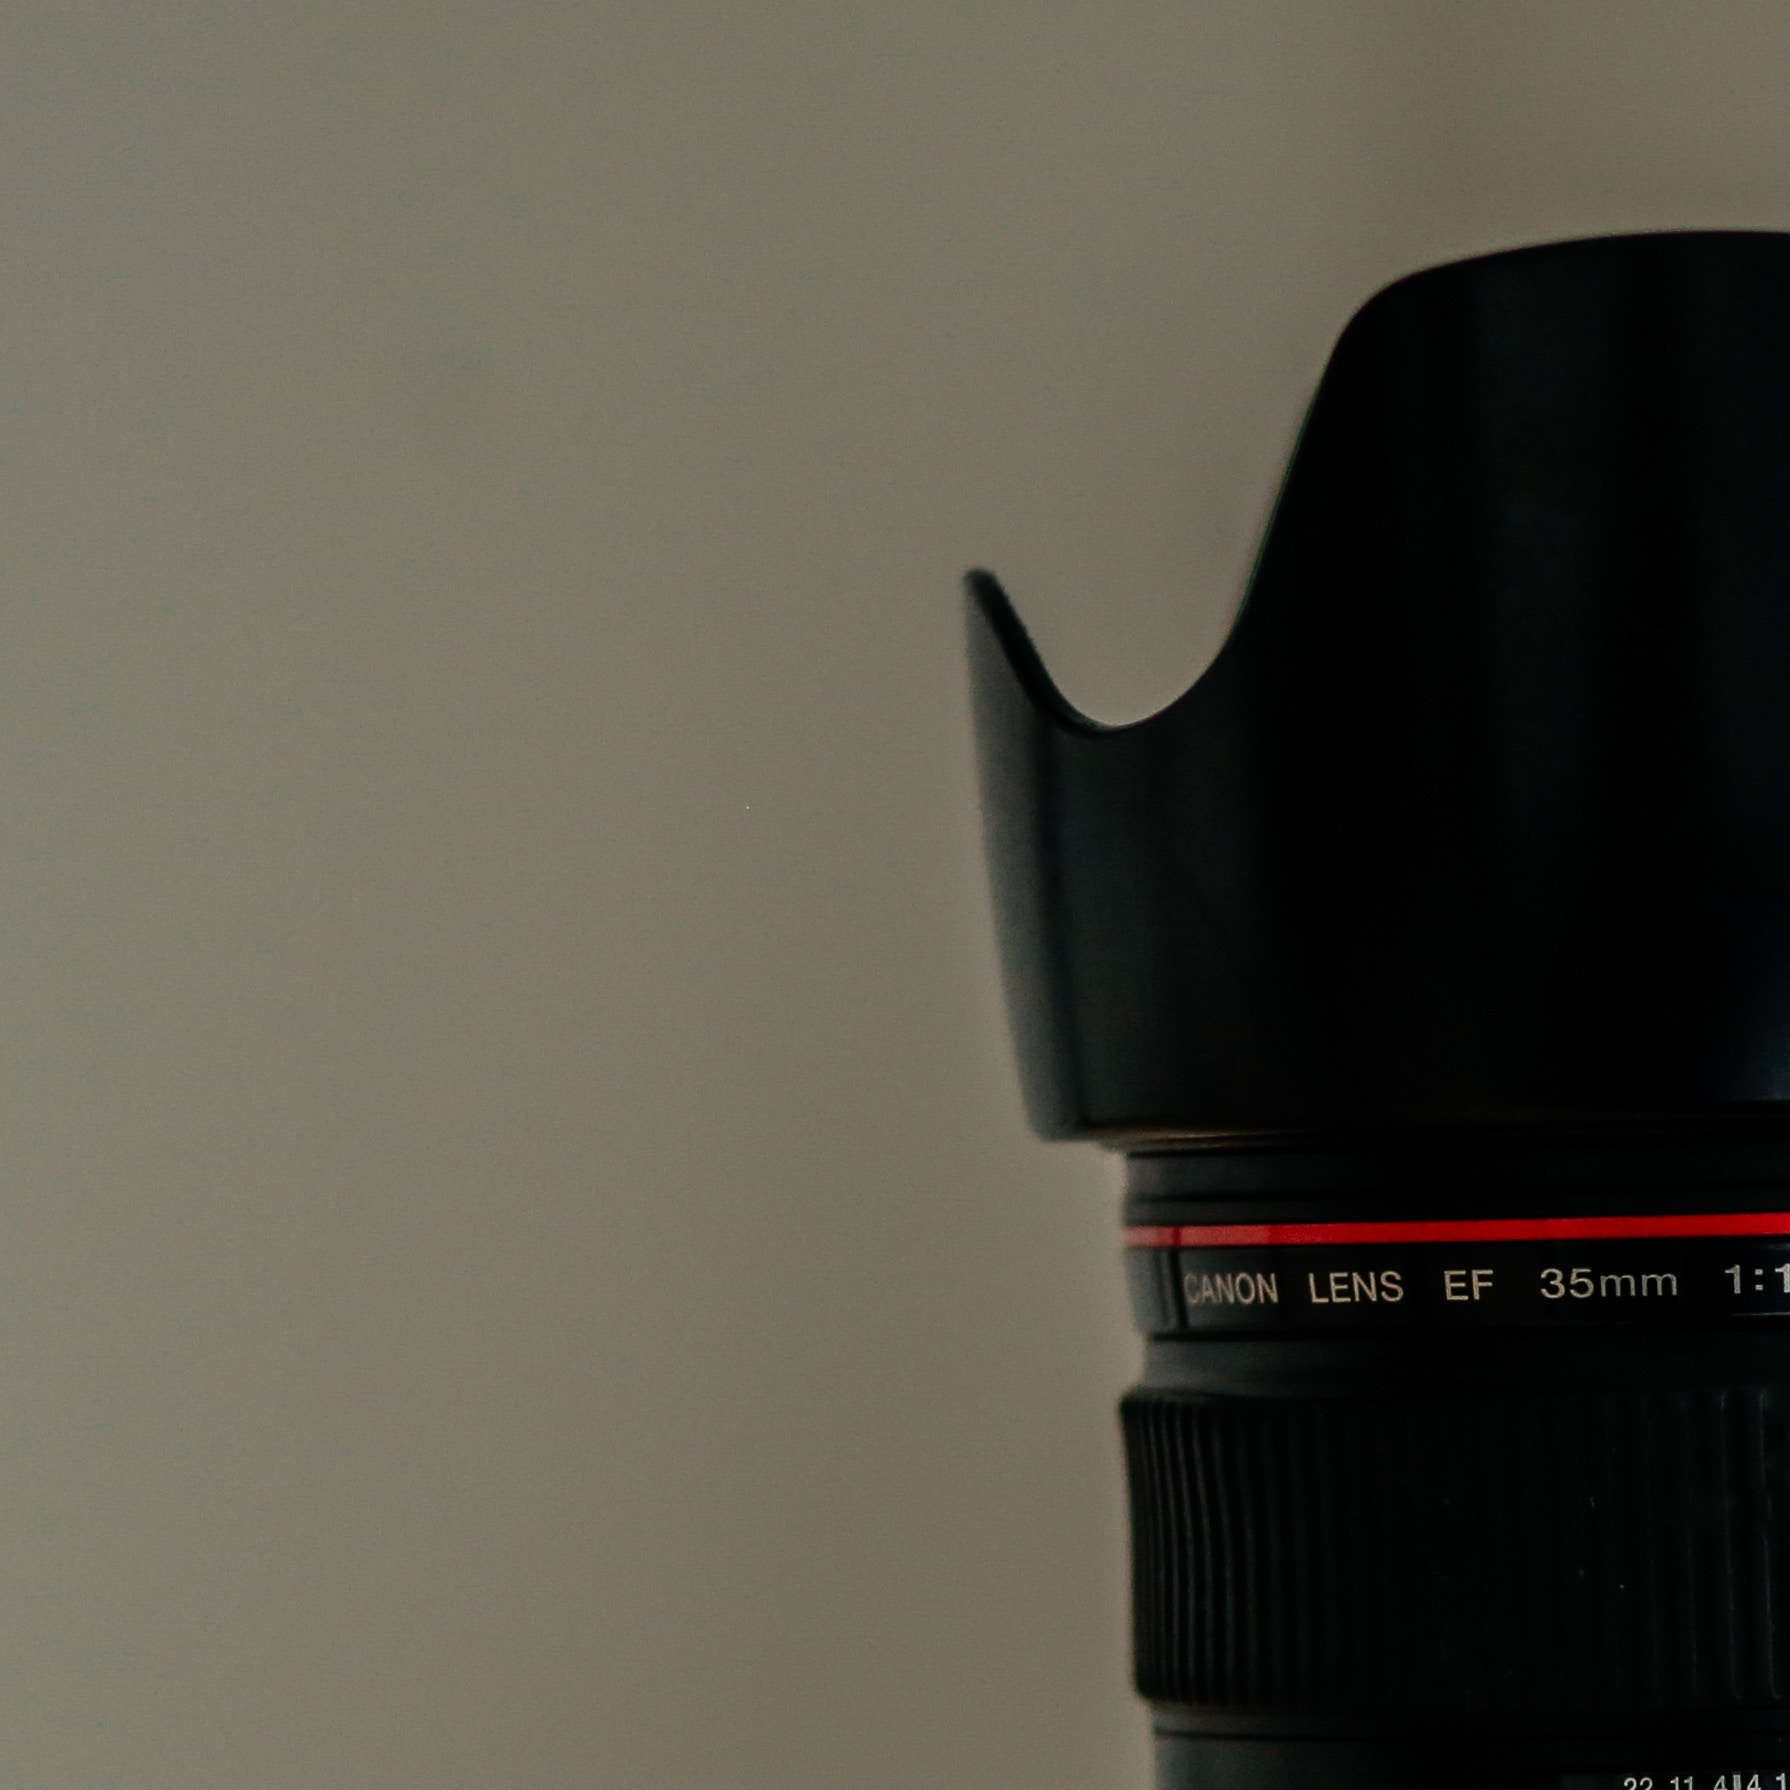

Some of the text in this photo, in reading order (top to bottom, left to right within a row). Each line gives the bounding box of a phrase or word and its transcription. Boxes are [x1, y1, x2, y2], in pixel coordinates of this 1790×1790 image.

[1184, 1271, 1278, 1307] CANON
[1308, 1270, 1405, 1305] LENS
[1444, 1267, 1494, 1302] EF
[1540, 1264, 1679, 1299] 35mm
